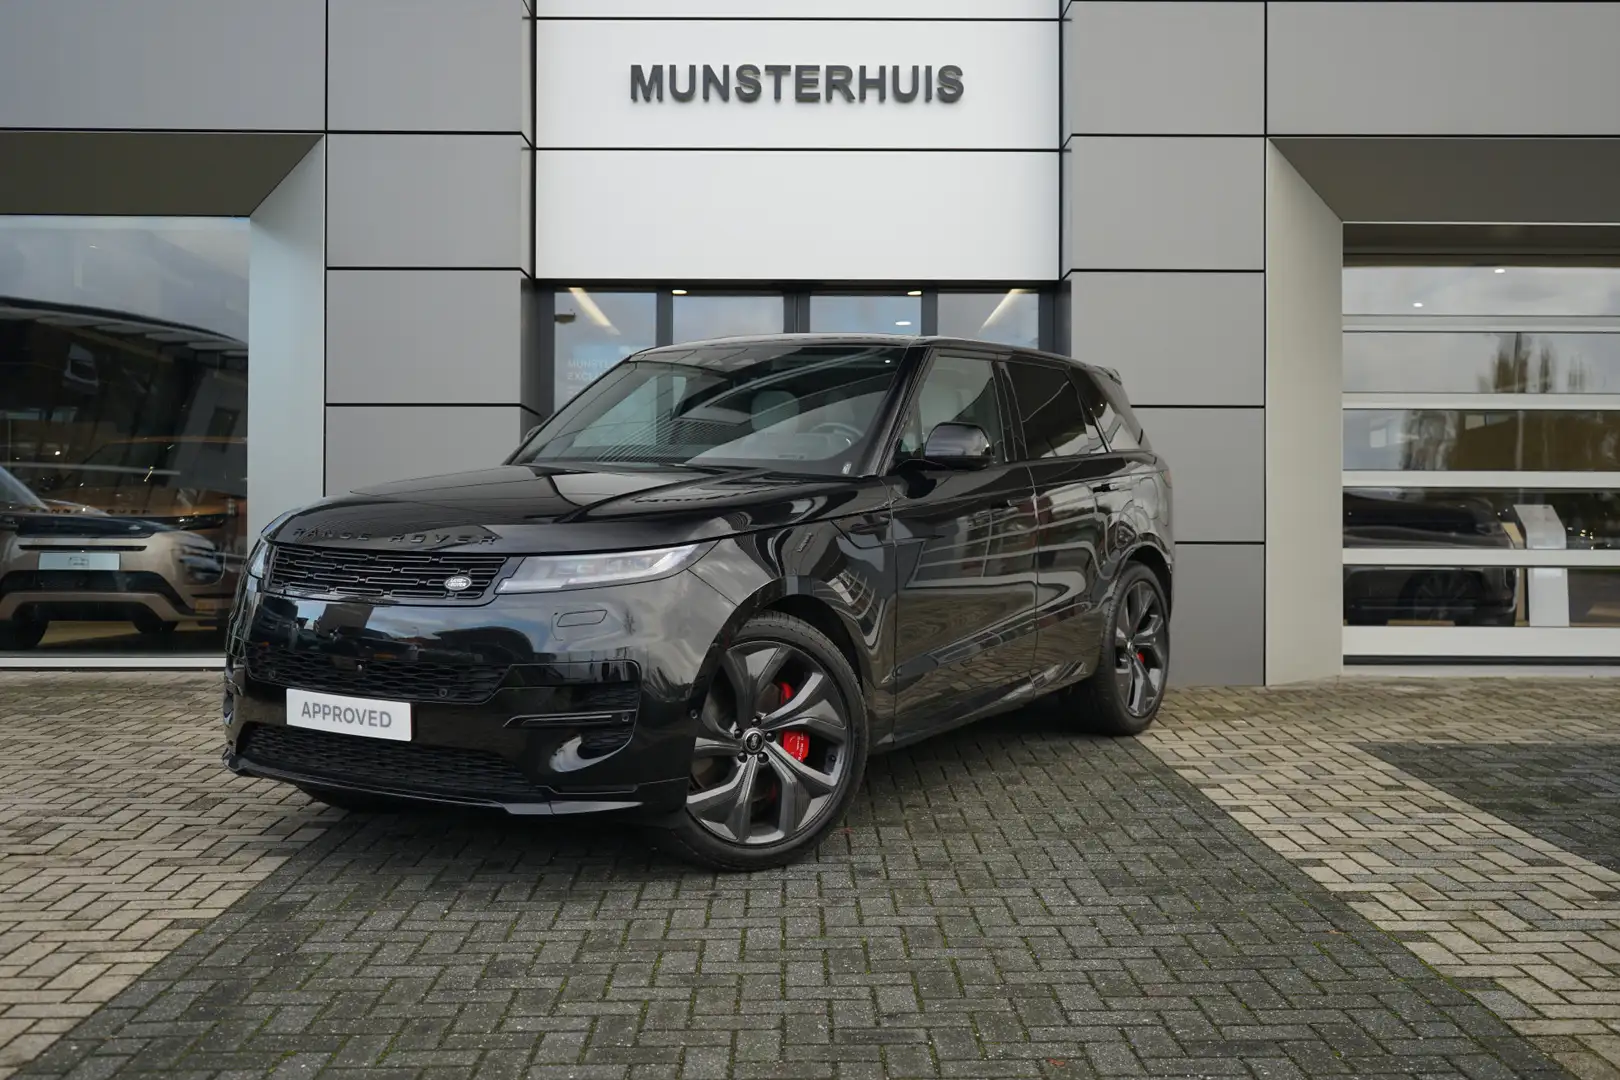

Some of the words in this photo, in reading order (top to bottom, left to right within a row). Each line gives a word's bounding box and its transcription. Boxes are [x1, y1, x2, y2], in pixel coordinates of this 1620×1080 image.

[630, 64, 964, 103] MUNSTERHUIS
[293, 528, 372, 541] RANGE
[387, 533, 496, 546] ROVER
[301, 701, 392, 728] APPROVED
